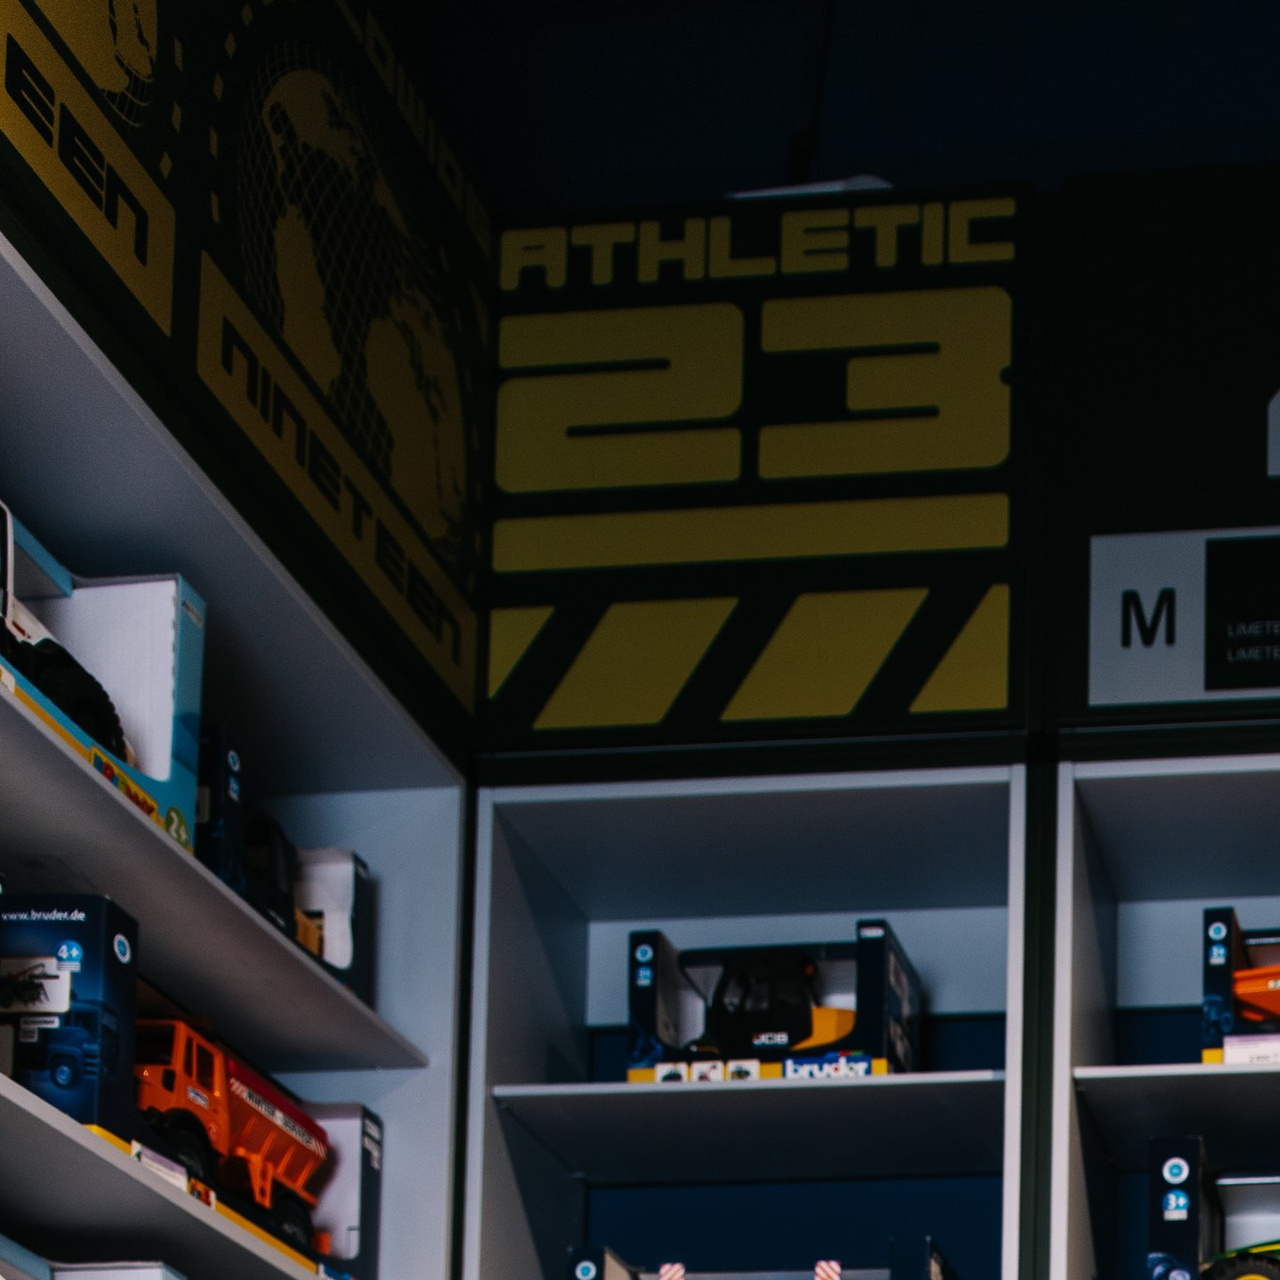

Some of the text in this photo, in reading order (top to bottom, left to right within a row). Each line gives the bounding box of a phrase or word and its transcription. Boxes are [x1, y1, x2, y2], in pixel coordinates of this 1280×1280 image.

[499, 197, 1016, 292] ATHLETIC
[495, 285, 1013, 494] 23
[221, 313, 462, 666] NINETEEN
[1119, 587, 1177, 649] M
[57, 944, 81, 960] 4+
[752, 1031, 789, 1045] JCB
[785, 1055, 869, 1079] bruder
[1167, 1193, 1187, 1208] 3+
